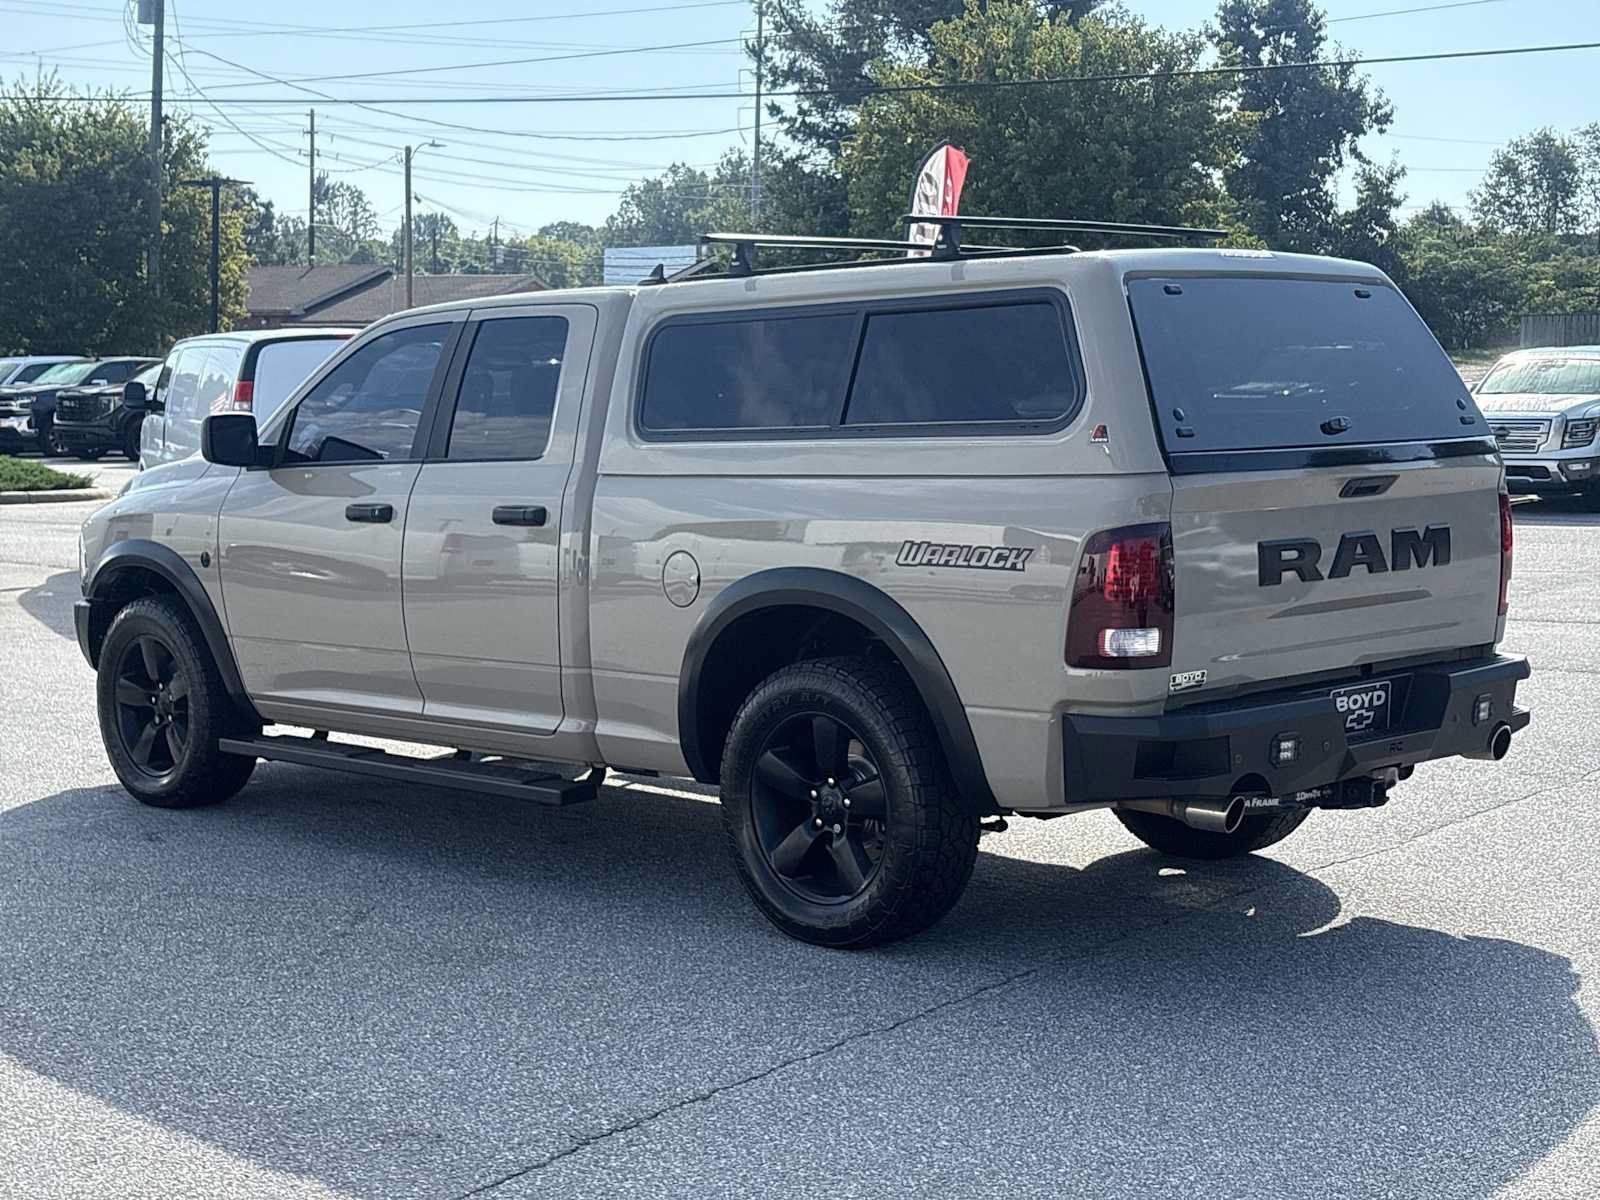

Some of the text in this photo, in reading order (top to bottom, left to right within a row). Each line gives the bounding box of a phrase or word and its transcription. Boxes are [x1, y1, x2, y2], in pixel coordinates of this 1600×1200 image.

[895, 540, 1034, 572] WARLOCK
[1257, 523, 1451, 587] RAM
[1335, 690, 1386, 712] BOYD
